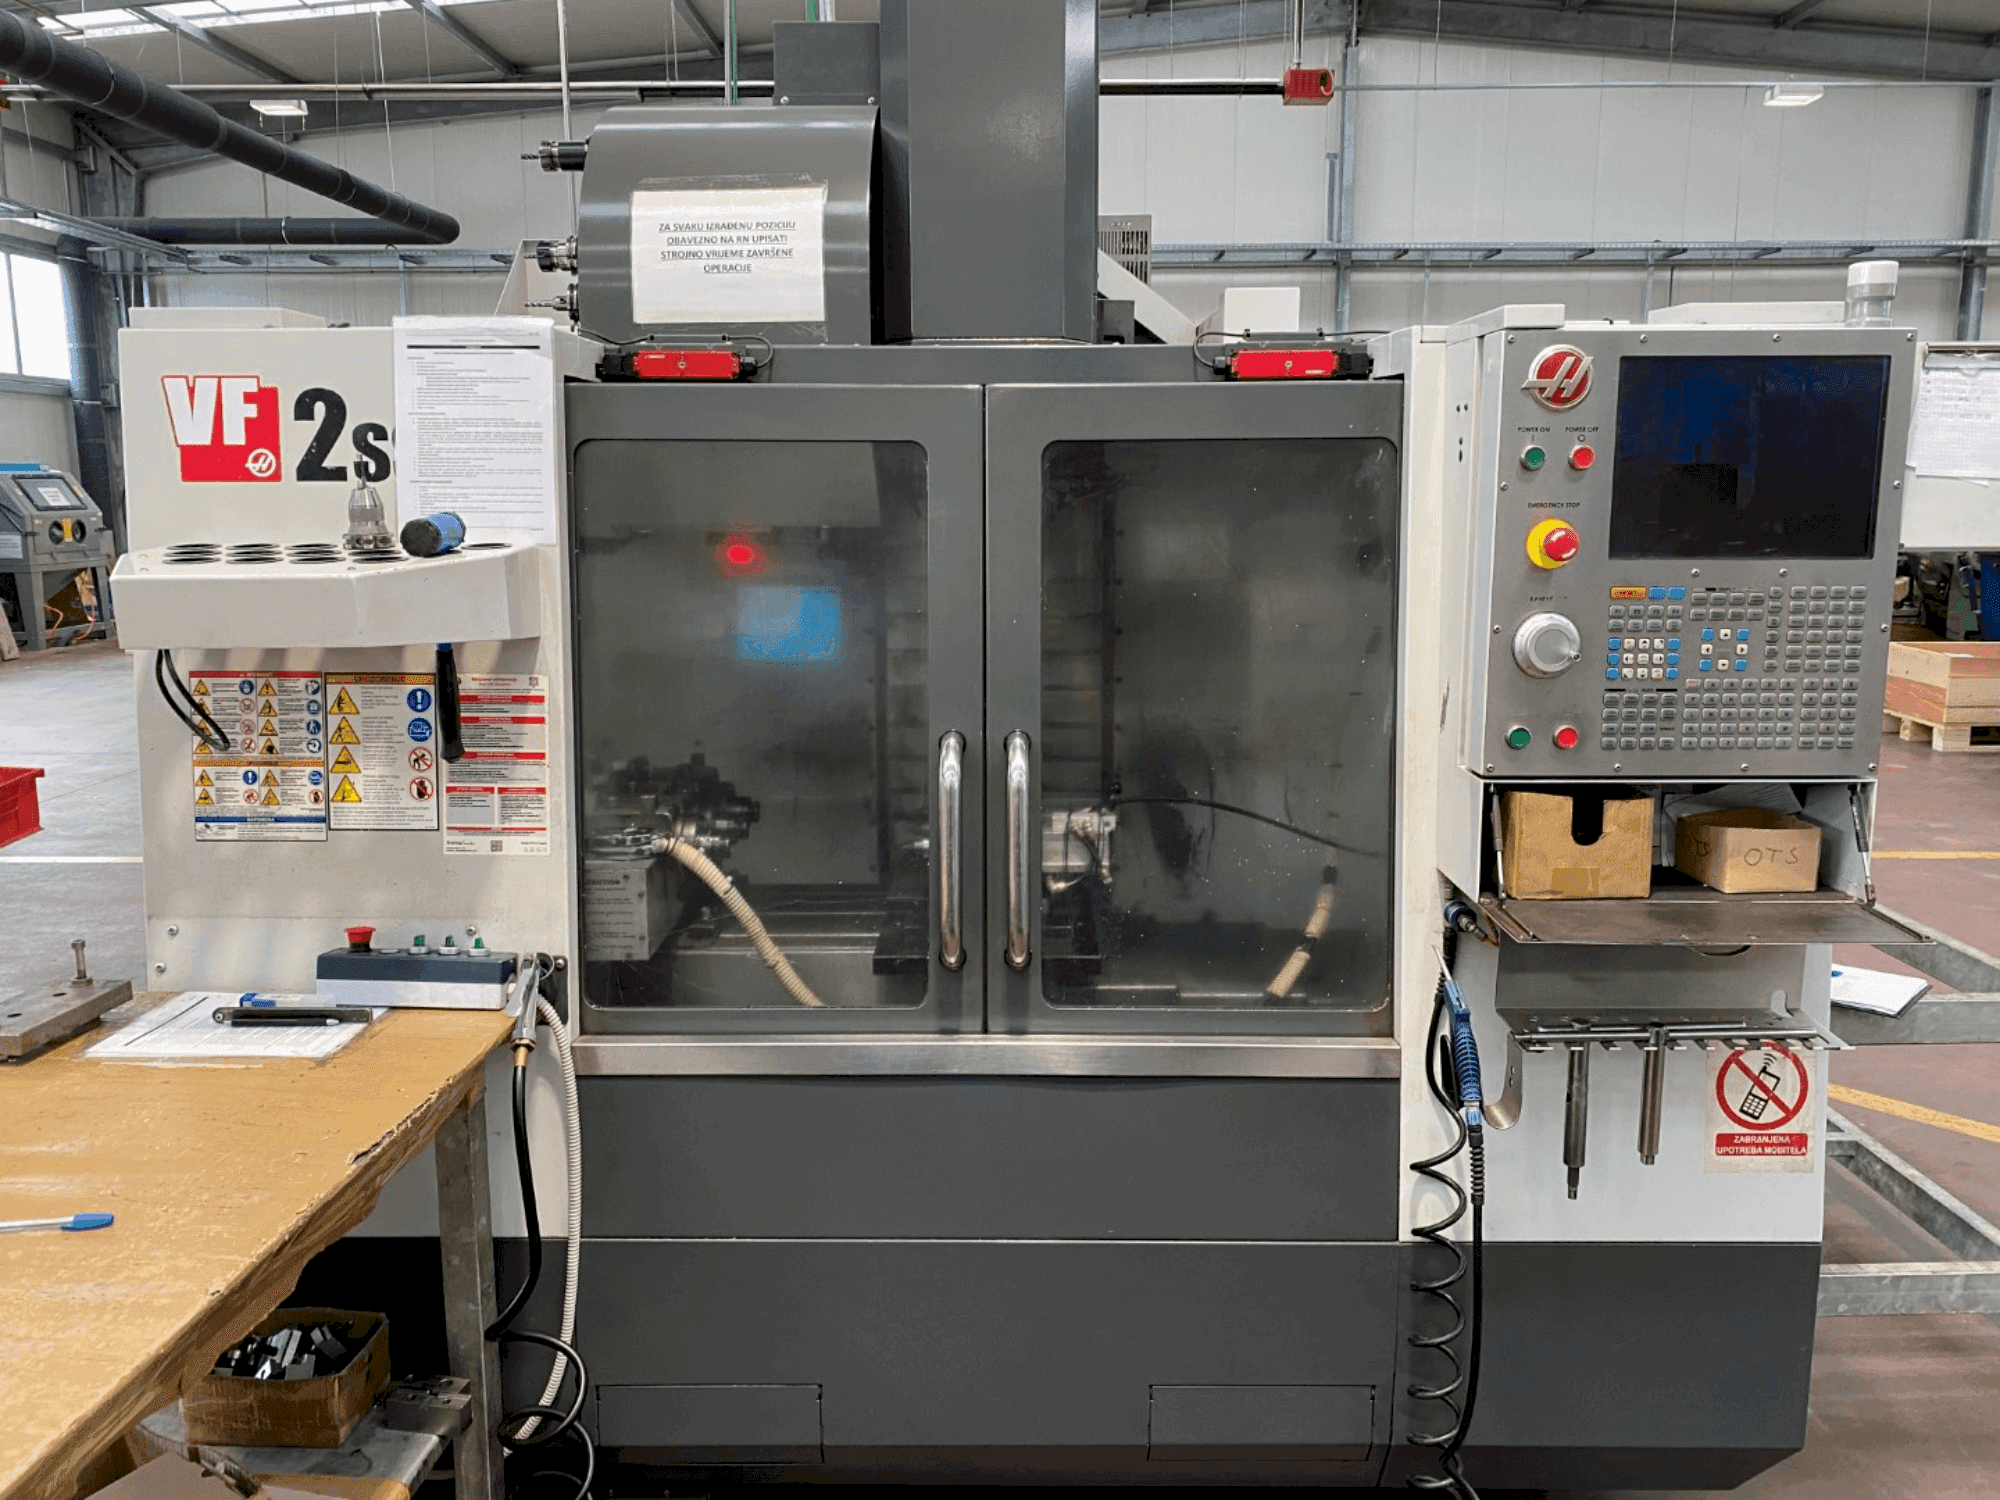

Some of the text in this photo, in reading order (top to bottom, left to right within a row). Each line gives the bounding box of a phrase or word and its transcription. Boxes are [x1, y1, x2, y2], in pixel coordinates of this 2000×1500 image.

[658, 220, 796, 232] ZA SVAKU IZRAĐENU POZICIJU
[667, 234, 788, 245] OBAVEZNO NA RN UPISATI
[661, 246, 794, 260] STROJNO VRIJEME ZAVRŠENE
[703, 263, 752, 273] OPERACIJE
[161, 375, 260, 447] VF
[294, 386, 397, 482] 2s
[1744, 847, 1799, 866] OTS
[1733, 1134, 1790, 1144] ZABRANJENA
[1717, 1146, 1807, 1155] UPOTREBA MOBITELA
